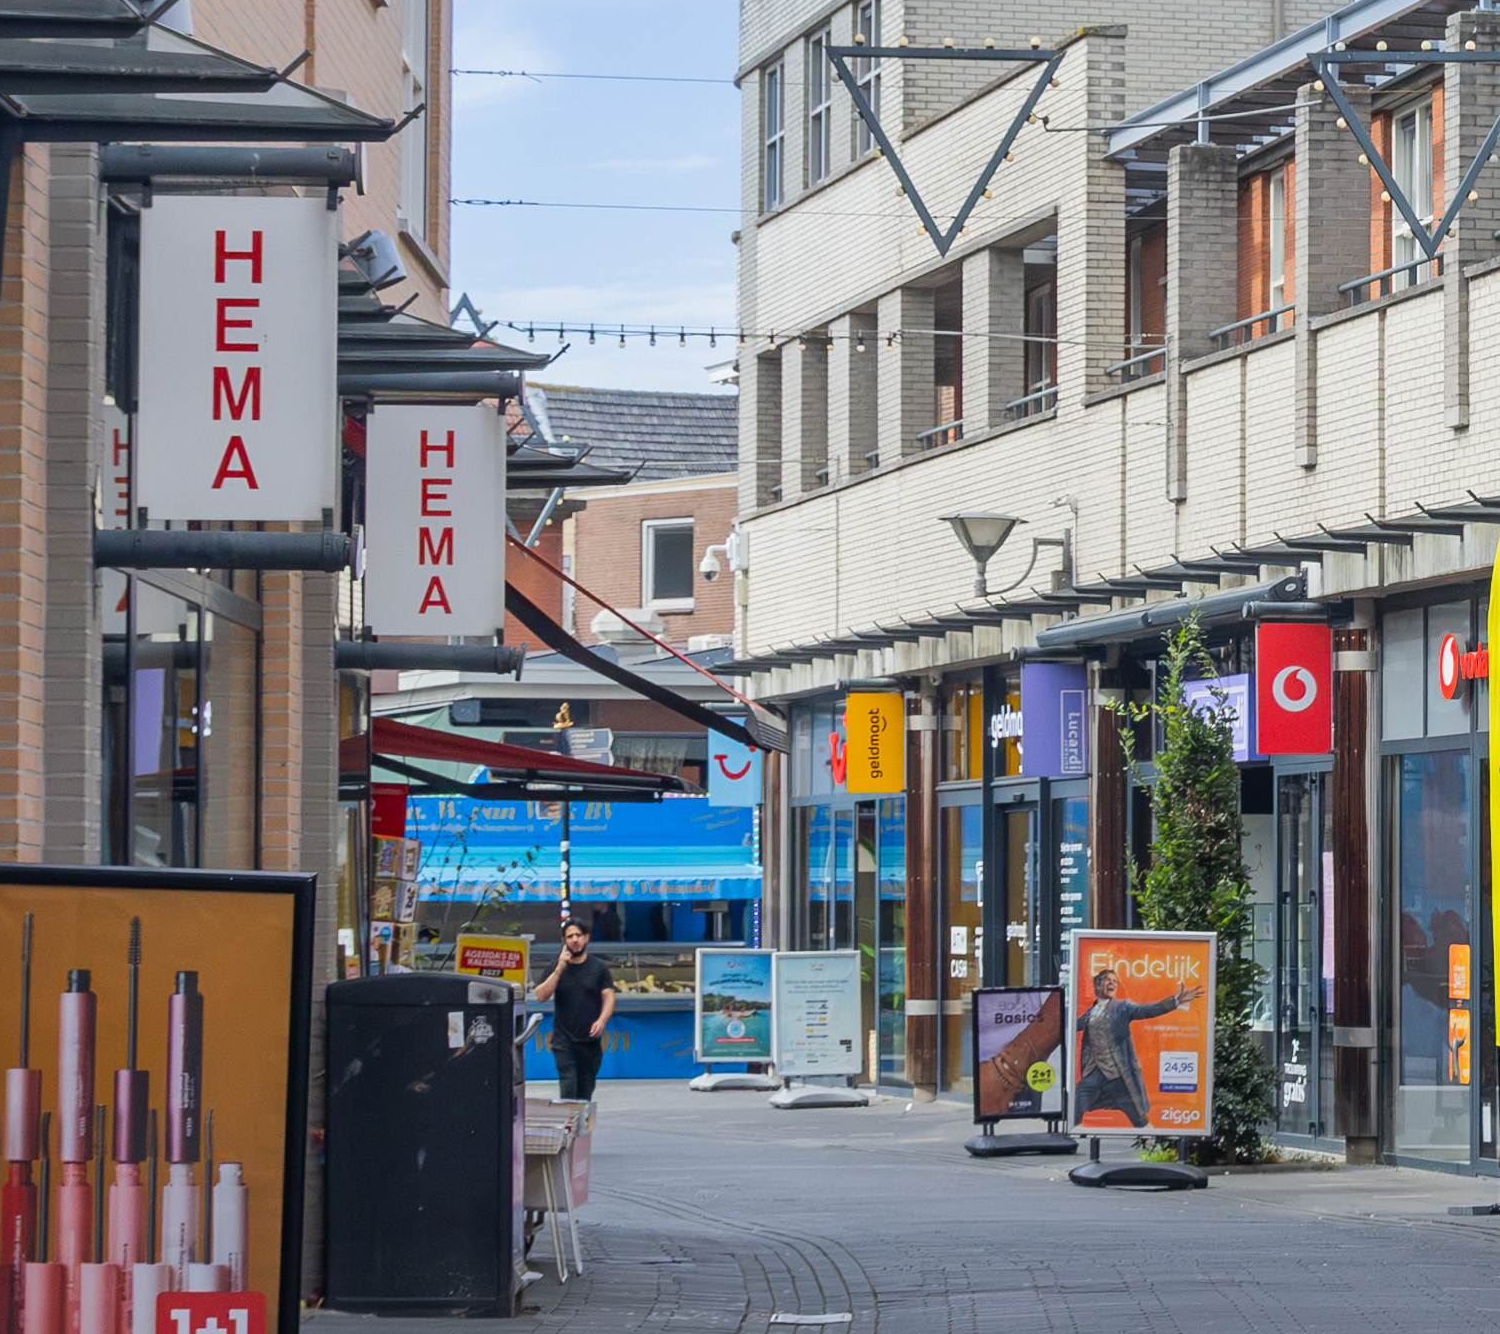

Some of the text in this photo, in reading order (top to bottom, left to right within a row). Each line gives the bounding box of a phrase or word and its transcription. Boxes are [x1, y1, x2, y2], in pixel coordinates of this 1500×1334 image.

[211, 229, 263, 491] HEMA
[417, 428, 456, 615] HEMA
[1459, 641, 1489, 680] voda
[1068, 712, 1082, 772] Lucardi
[1088, 950, 1201, 986] Eindelijk
[994, 1010, 1045, 1025] Basics
[1163, 1061, 1195, 1075] 24,95
[1160, 1107, 1201, 1125] ziggo
